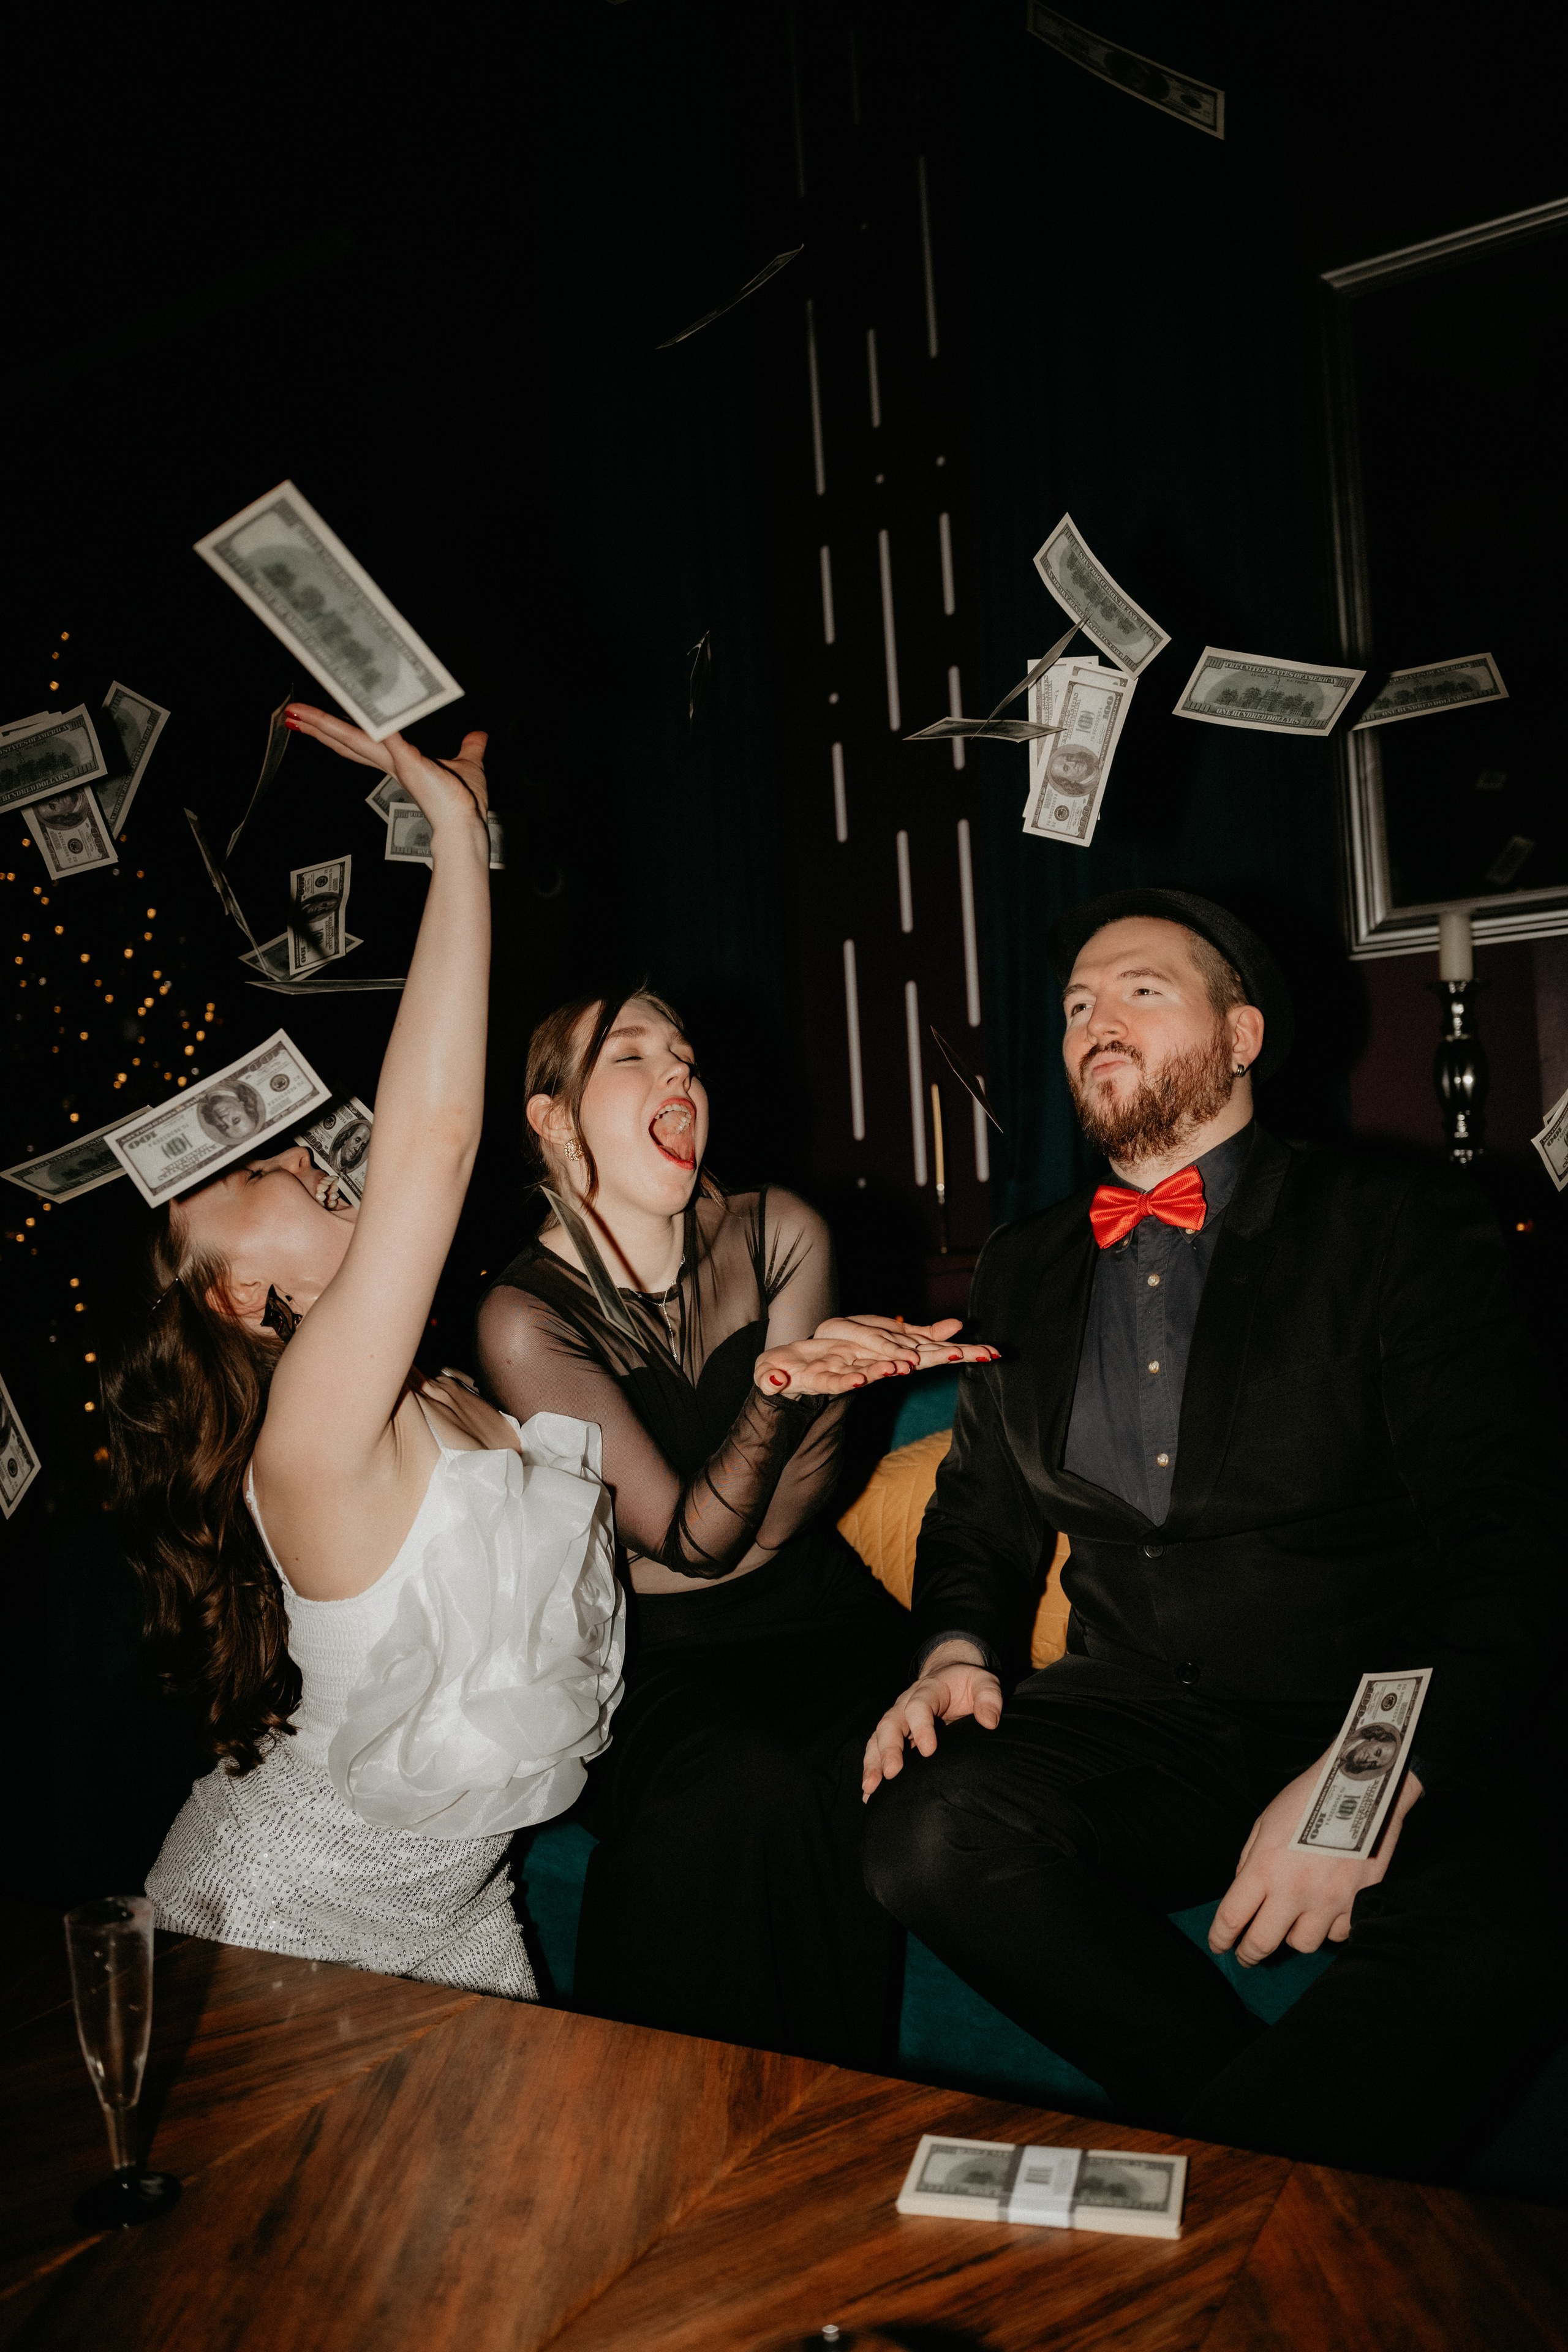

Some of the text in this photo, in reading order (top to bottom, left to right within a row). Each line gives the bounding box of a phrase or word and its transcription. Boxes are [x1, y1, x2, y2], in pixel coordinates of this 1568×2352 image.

[1047, 570, 1070, 600] AMERICA
[1078, 551, 1138, 622] ONE HUNDRED DOLLARS
[1073, 605, 1094, 628] STTES
[1091, 625, 1112, 646] UNITED
[1110, 643, 1123, 658] THE
[1240, 664, 1267, 673] UNITED
[1265, 668, 1295, 677] STATES
[1300, 673, 1336, 684] AMERICA
[1101, 695, 1114, 721] 100
[1396, 701, 1433, 713] HUNDRED
[1433, 694, 1468, 706] DOLLARS
[1102, 722, 1113, 750] HUNDRED
[1110, 695, 1121, 722] DOLLARS
[1231, 709, 1268, 720] HUNDRED
[1265, 715, 1301, 725] DOLLARS
[2, 723, 69, 754] STATES OF AMERICA
[134, 737, 147, 762] UNITED
[2, 772, 69, 802] HUNDRED DOLLARS
[126, 1129, 158, 1152] 100
[303, 1130, 324, 1152] 100
[1542, 1121, 1560, 1143] DOLLARS
[1545, 1126, 1562, 1148] 100
[78, 1173, 96, 1182] ONE
[347, 1180, 361, 1196] HUNDRED
[1314, 1779, 1332, 1810] HUNDRED
[1300, 1811, 1318, 1841] DOLLARS
[1309, 1812, 1327, 1839] 100
